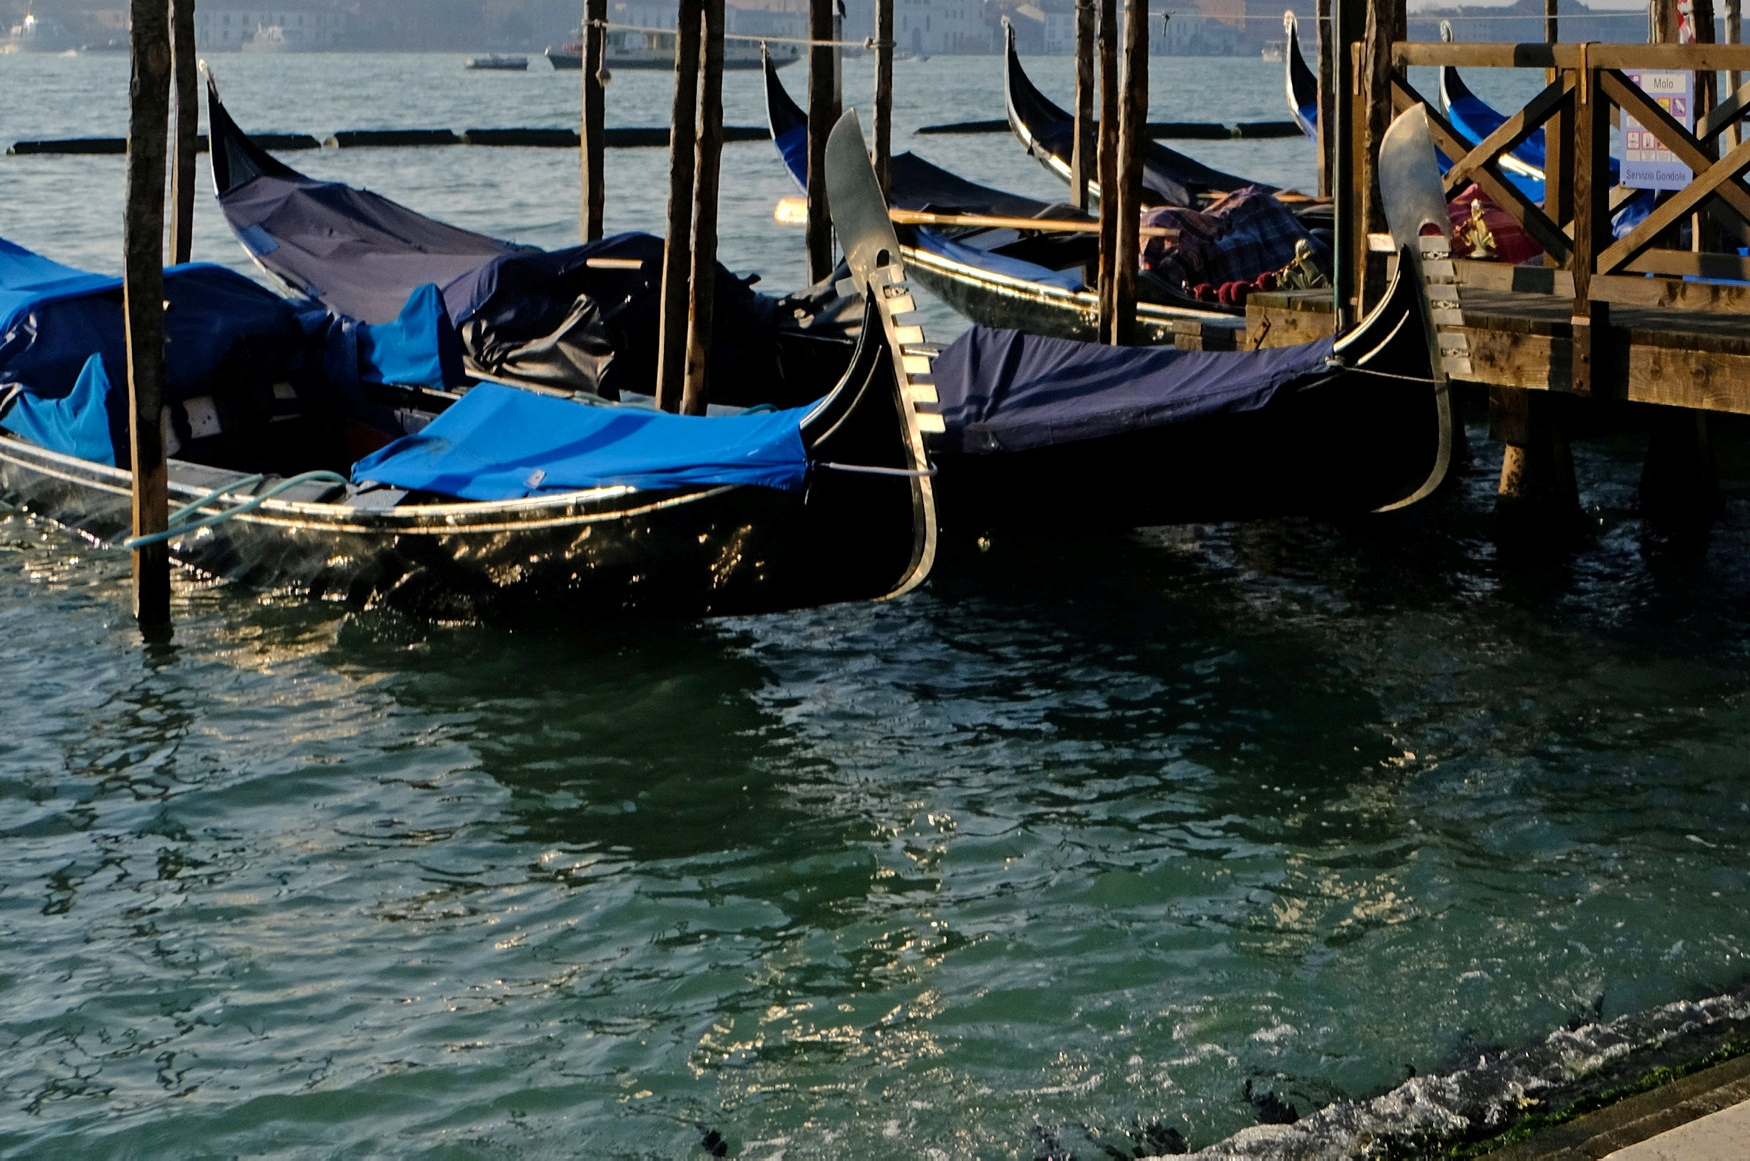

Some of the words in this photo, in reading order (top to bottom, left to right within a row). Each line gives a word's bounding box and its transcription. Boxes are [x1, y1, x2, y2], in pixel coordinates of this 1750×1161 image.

[1653, 78, 1674, 89] Molo
[1626, 169, 1654, 181] Servizio
[1655, 171, 1686, 183] Gondole
